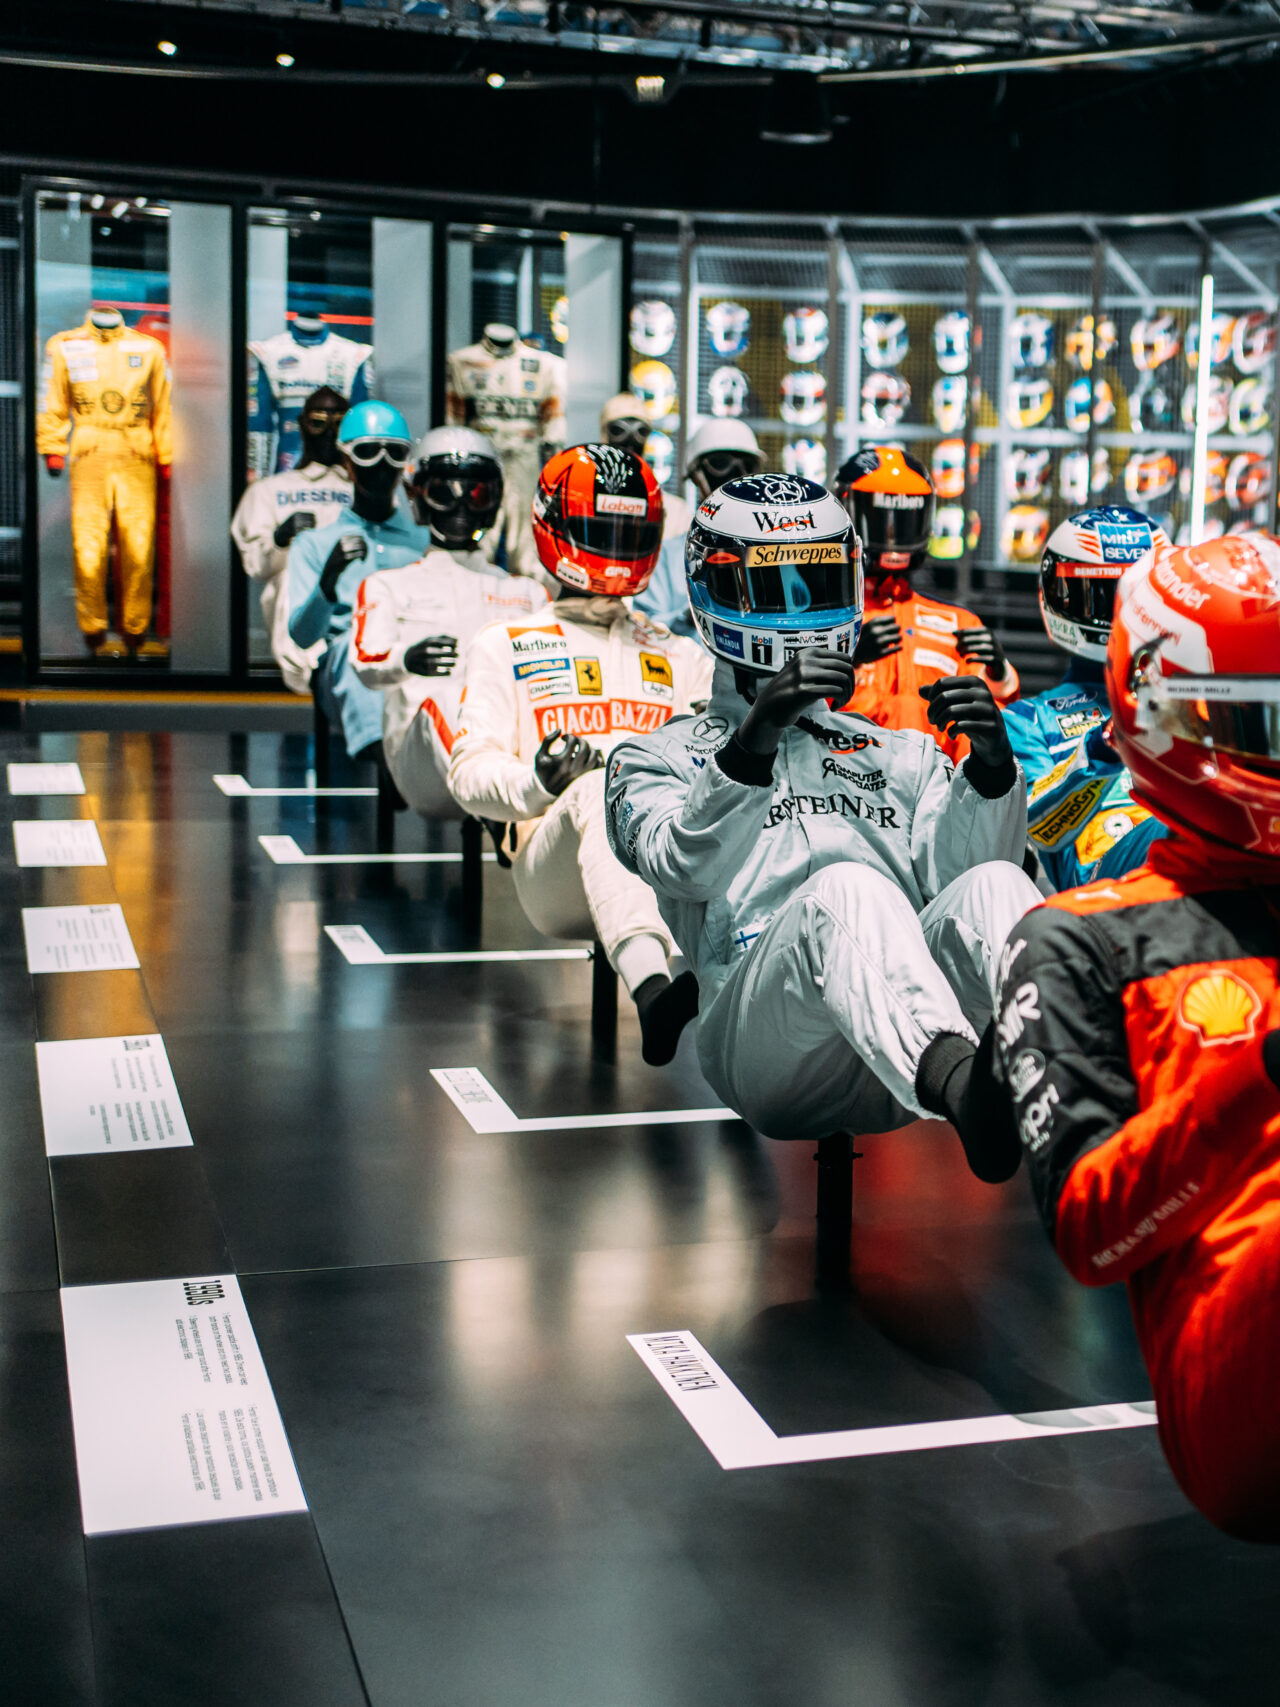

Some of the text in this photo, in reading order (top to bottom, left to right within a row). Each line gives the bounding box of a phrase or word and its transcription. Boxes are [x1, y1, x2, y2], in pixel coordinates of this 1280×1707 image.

[873, 491, 925, 510] Marlboro
[752, 510, 818, 534] West
[1102, 531, 1141, 545] MILD
[753, 546, 842, 566] Schweppes
[1074, 566, 1122, 577] BENETTON
[512, 639, 567, 653] Marlboro
[751, 635, 773, 645] Mobil
[757, 645, 766, 665] 1
[518, 660, 566, 676] MICHELIN
[529, 682, 570, 695] CHAMPION
[181, 1278, 226, 1307] 1990s
